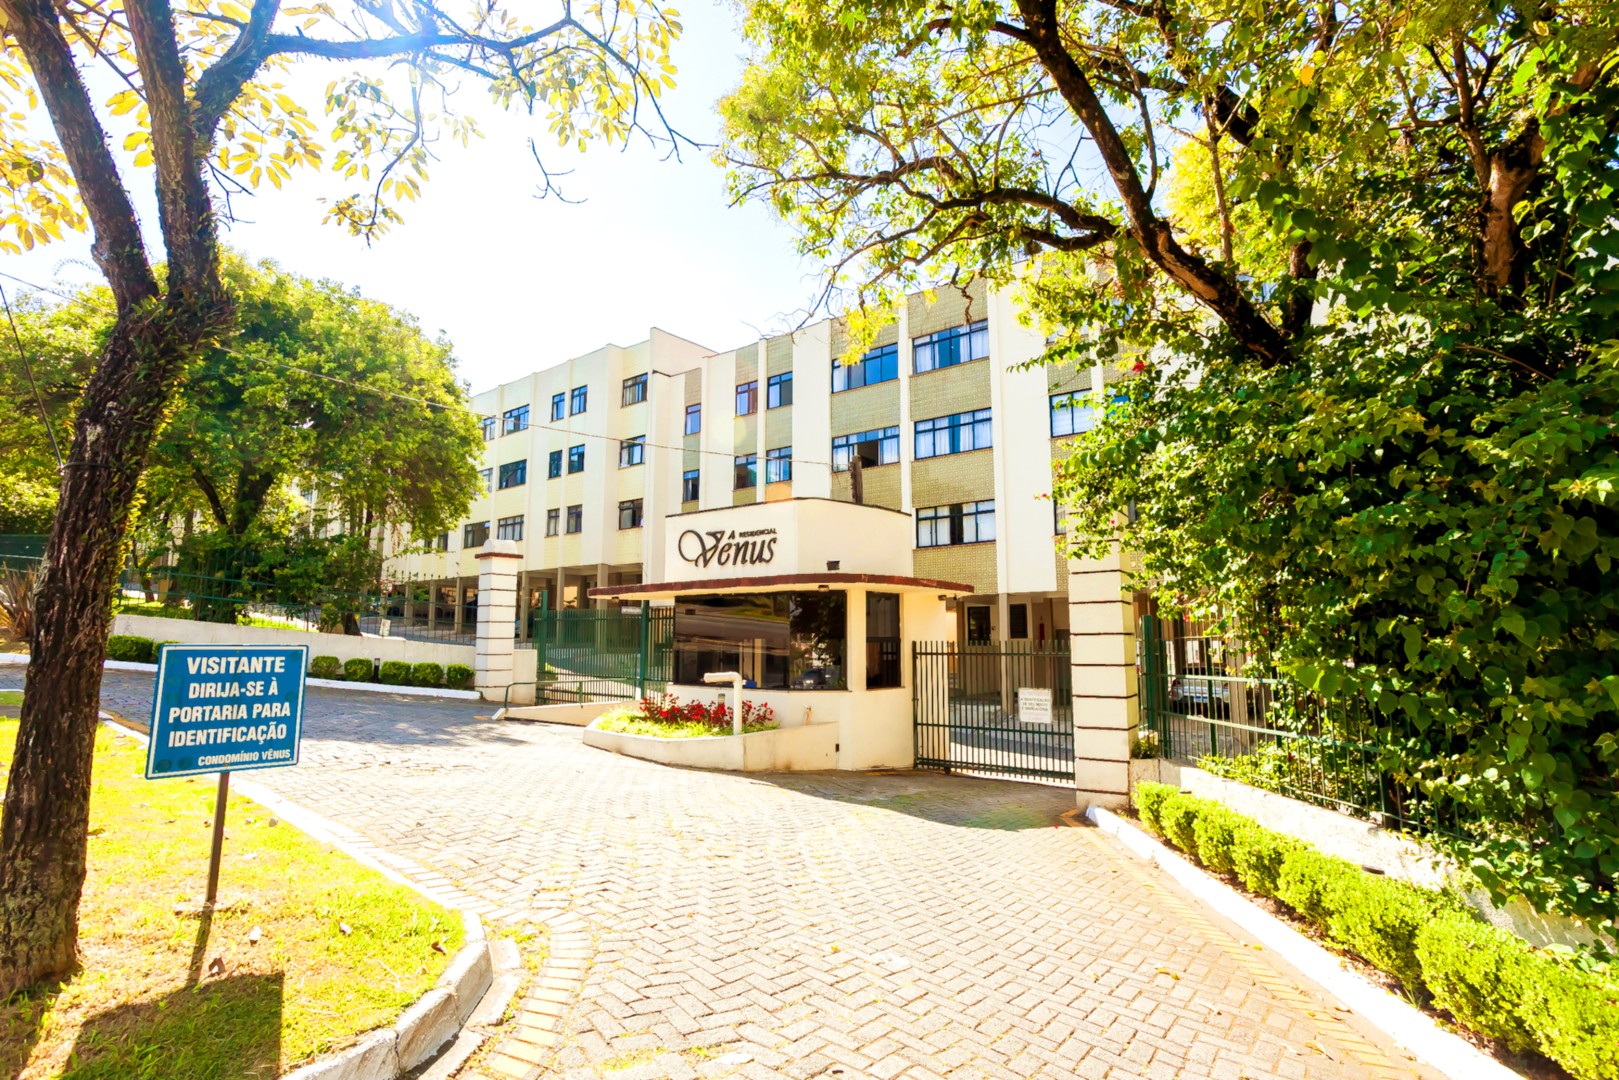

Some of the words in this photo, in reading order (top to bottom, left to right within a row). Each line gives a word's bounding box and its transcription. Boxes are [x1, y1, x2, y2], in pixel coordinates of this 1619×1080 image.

[187, 656, 285, 674] VISITANTE
[188, 680, 264, 699] DIRIJA-SE
[268, 677, 278, 695] À
[168, 704, 248, 723] PORTARIA
[252, 702, 291, 719] PARA
[168, 721, 287, 747] IDENTIFICAÇÃO
[198, 750, 259, 766] CONDOMÍNIO
[261, 748, 291, 761] VÊNUS
